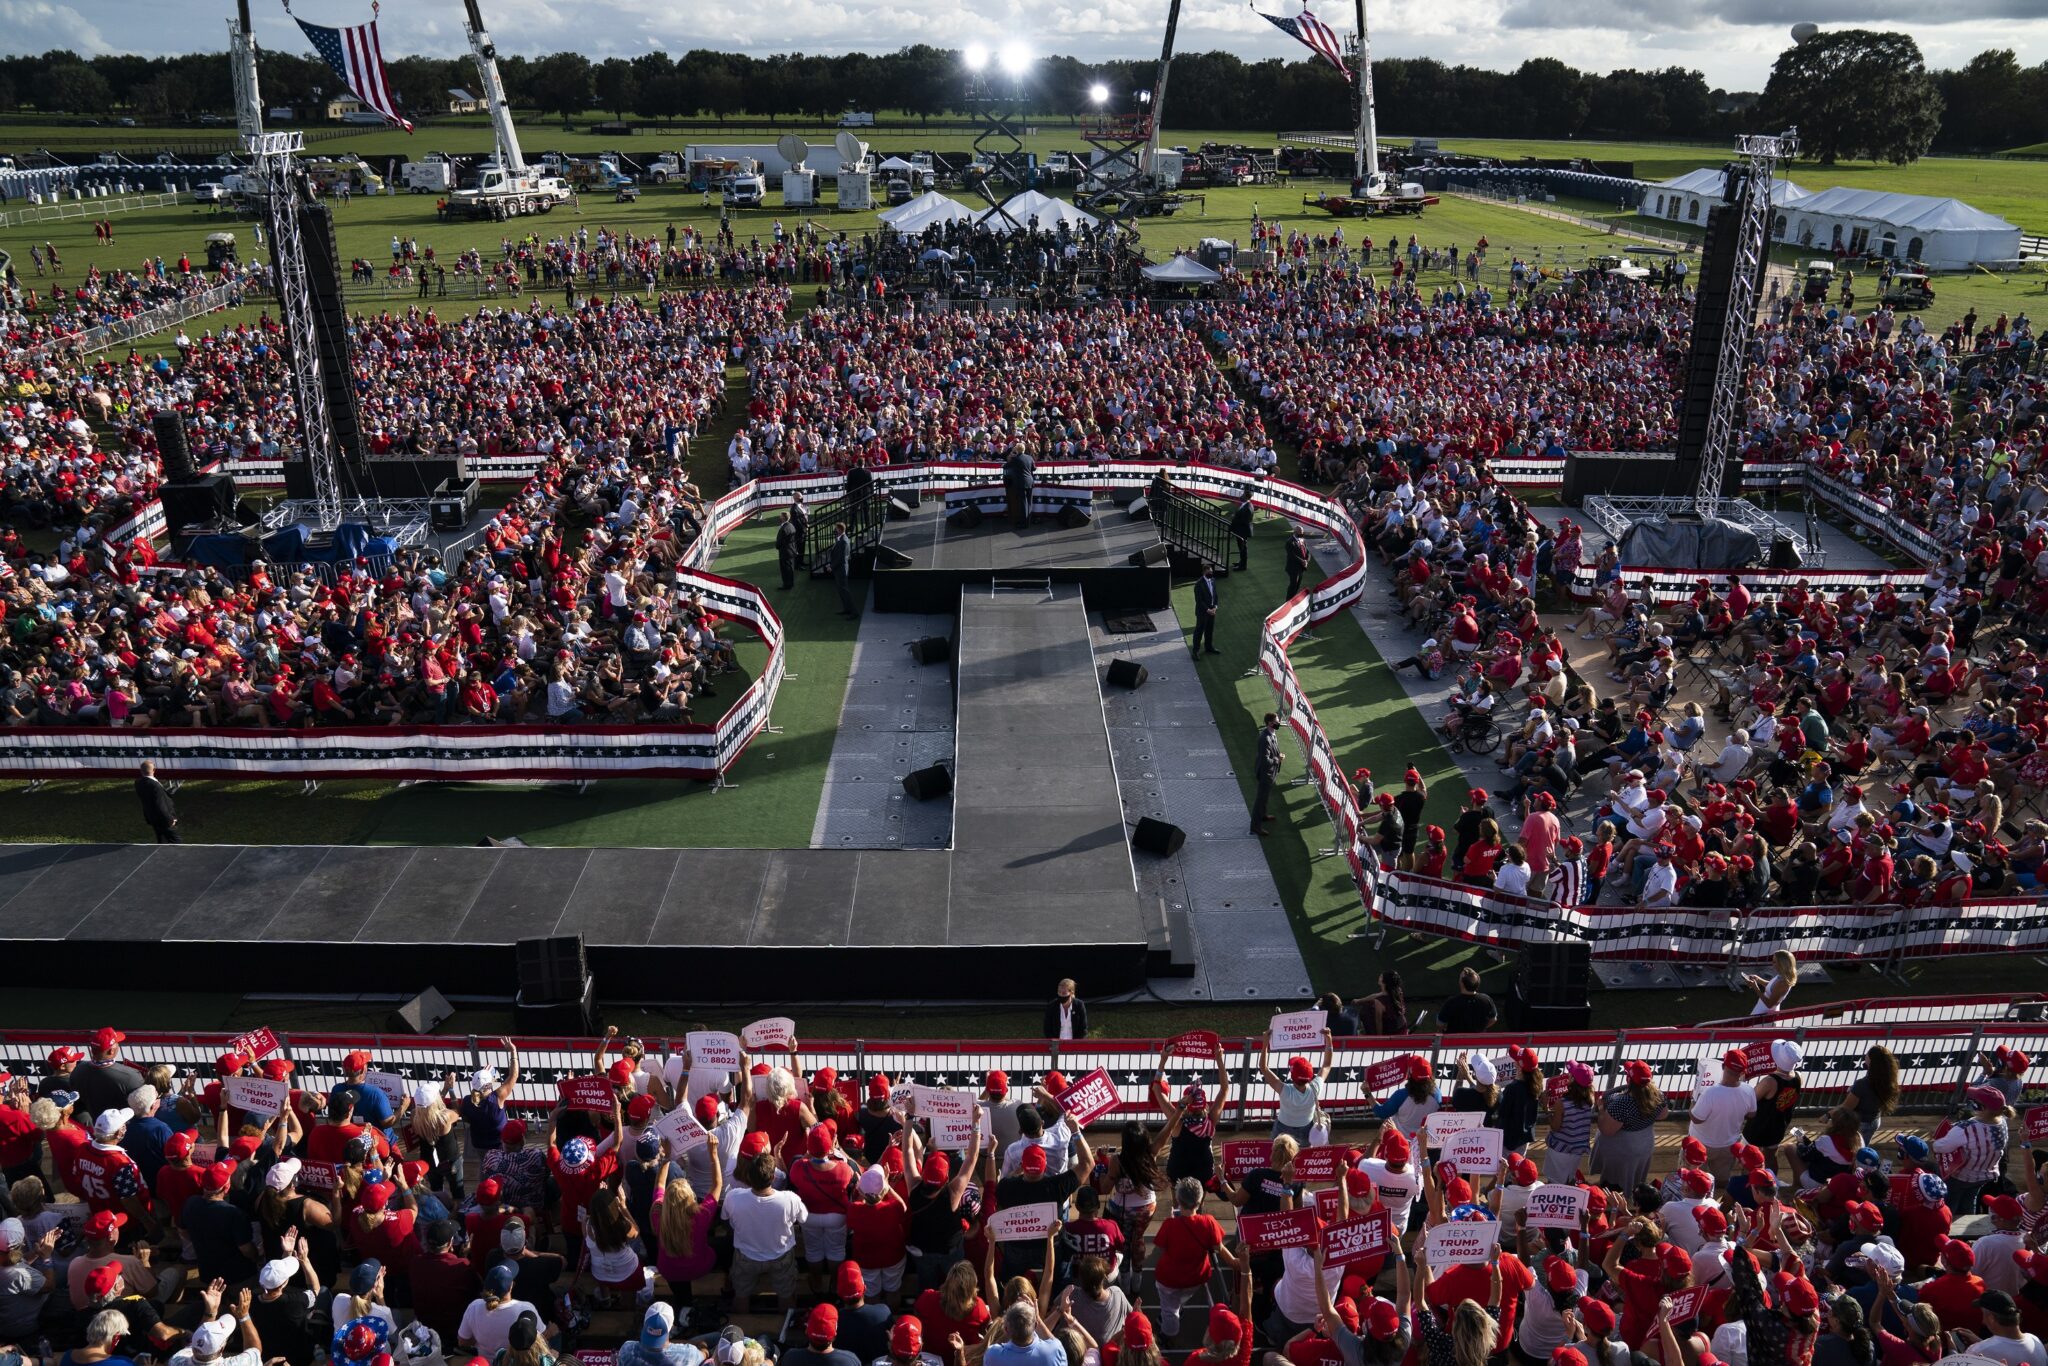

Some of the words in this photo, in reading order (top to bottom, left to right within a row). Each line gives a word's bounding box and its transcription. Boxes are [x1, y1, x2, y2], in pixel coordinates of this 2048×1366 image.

[1288, 1017, 1309, 1025] TEXT
[1291, 1033, 1317, 1041] 88022
[705, 1038, 726, 1046] TEXT
[710, 1056, 736, 1064] 88022
[1379, 1062, 1397, 1072] TEXT
[1754, 1062, 1776, 1071] 88022
[1375, 1067, 1401, 1080] TRUMP
[244, 1080, 268, 1090] TEXT
[577, 1081, 600, 1089] TEXT
[1371, 1080, 1381, 1088] TO
[1382, 1073, 1404, 1085] 88022
[240, 1087, 273, 1098] TRUMP
[1064, 1077, 1103, 1107] TRUMP
[235, 1093, 248, 1102] TO
[250, 1097, 278, 1110] 88022
[586, 1097, 611, 1107] 88022
[1079, 1086, 1111, 1110] VOTE
[927, 1100, 961, 1108] TRUMP
[1442, 1119, 1465, 1127] TEXT
[946, 1124, 972, 1132] TRUM
[1458, 1136, 1480, 1145] TEXT
[1237, 1147, 1261, 1155] TEXT
[1452, 1146, 1486, 1155] TRUMP
[1234, 1157, 1265, 1165] TRUMP
[1303, 1158, 1332, 1166] TRUMP
[1460, 1157, 1491, 1165] 88022
[78, 1158, 105, 1176] TRUMP
[1230, 1167, 1241, 1175] TO
[1307, 1167, 1333, 1175] 88022
[81, 1174, 110, 1200] 45
[1531, 1194, 1576, 1205] TRUMP
[1540, 1203, 1576, 1215] VOTE
[1009, 1210, 1035, 1218] TEXT
[1003, 1217, 1040, 1227] TRUMP
[1263, 1217, 1293, 1231] TEXT
[998, 1227, 1013, 1235] TO
[1015, 1225, 1048, 1233] 88022
[1259, 1227, 1302, 1242] TRUMP
[1327, 1219, 1382, 1241] TRUMP
[1447, 1229, 1476, 1237] TEXT
[1273, 1234, 1310, 1247] 88022
[1340, 1229, 1383, 1248] VOTE
[1439, 1239, 1480, 1247] TRUMP
[1431, 1249, 1446, 1257] TO
[1449, 1248, 1484, 1257] 88022
